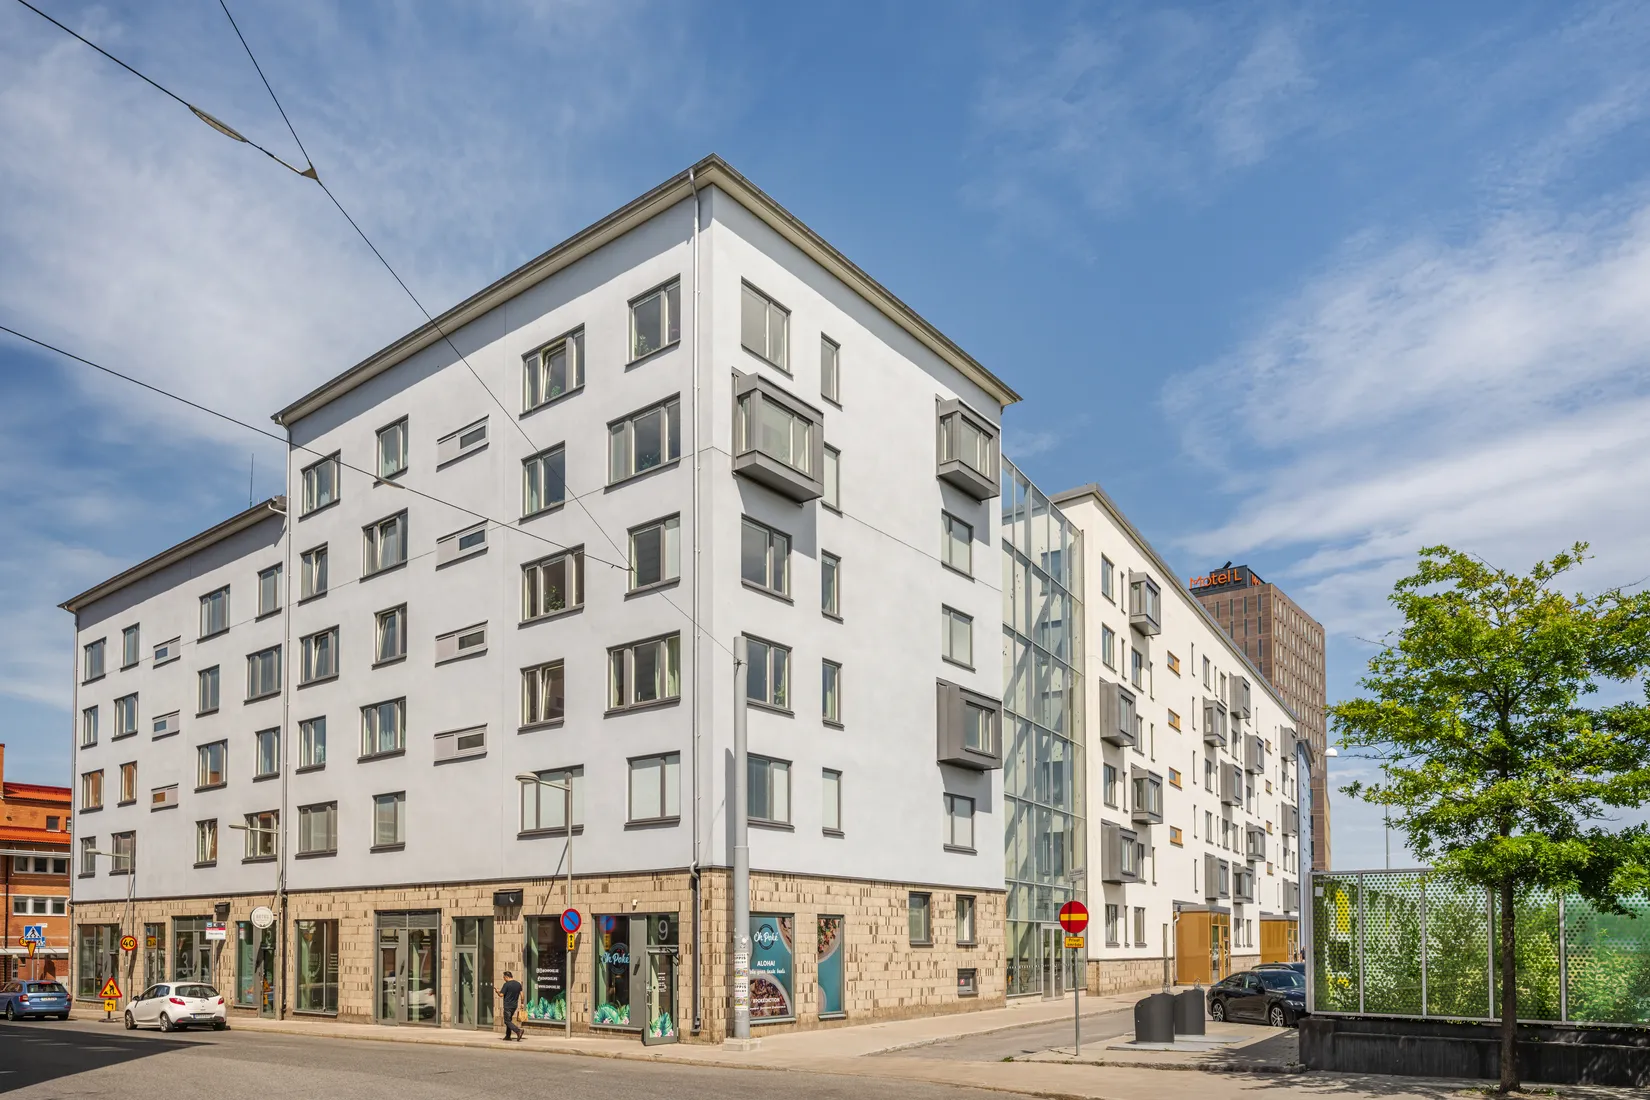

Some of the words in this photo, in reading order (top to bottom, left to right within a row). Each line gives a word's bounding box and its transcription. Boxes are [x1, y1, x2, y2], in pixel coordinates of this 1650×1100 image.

[1189, 569, 1230, 589] Motel
[1234, 568, 1242, 581] L
[658, 919, 668, 941] 9
[754, 931, 763, 942] Oh
[122, 939, 135, 948] 40
[181, 951, 189, 975] 3
[417, 949, 428, 978] 7
[601, 952, 612, 964] Oh
